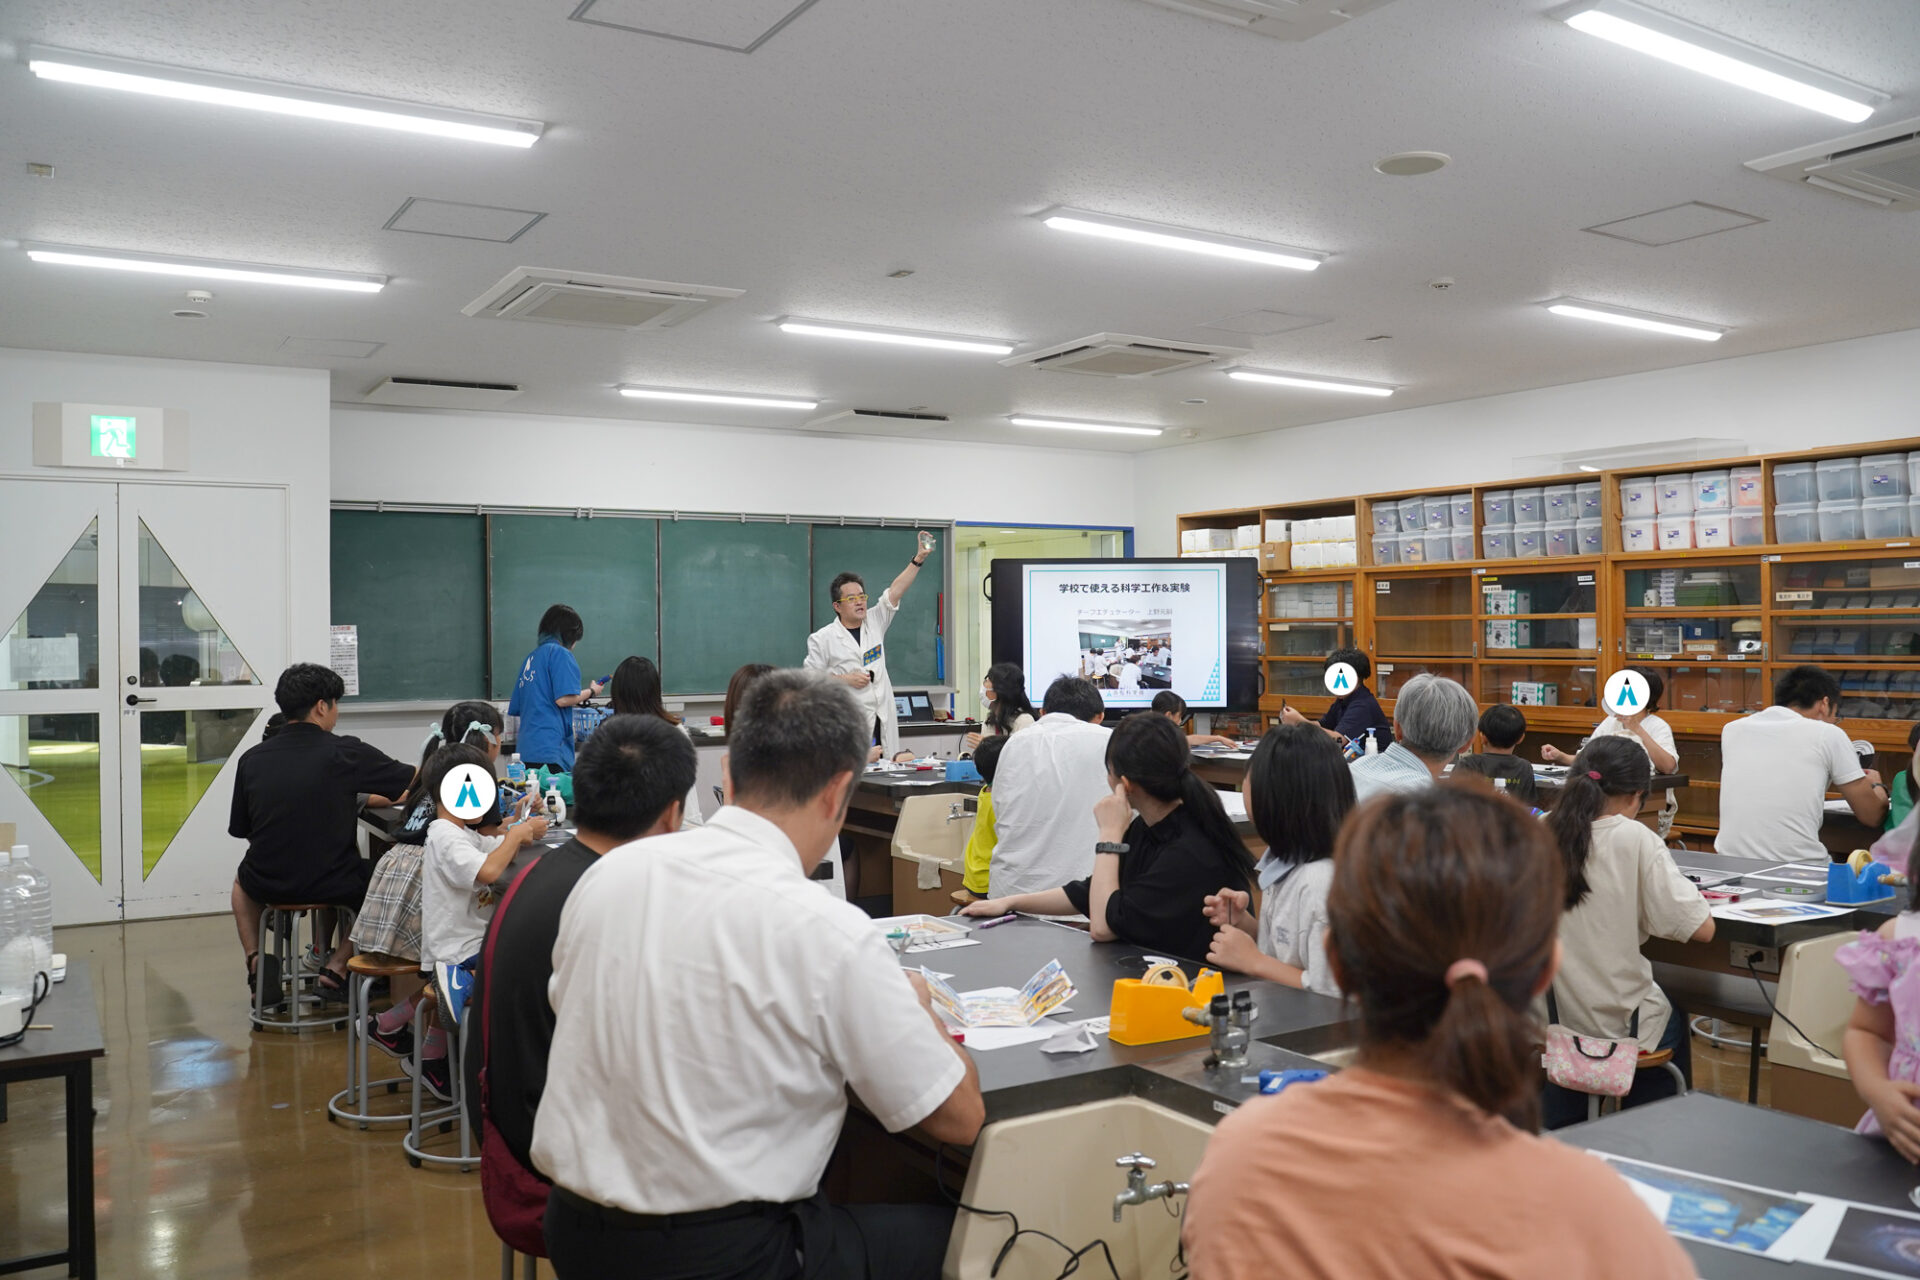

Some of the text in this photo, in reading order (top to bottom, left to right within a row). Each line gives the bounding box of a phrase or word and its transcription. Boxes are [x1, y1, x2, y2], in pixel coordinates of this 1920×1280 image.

[1058, 583, 1191, 593] 学校で使える科学工作&実験
